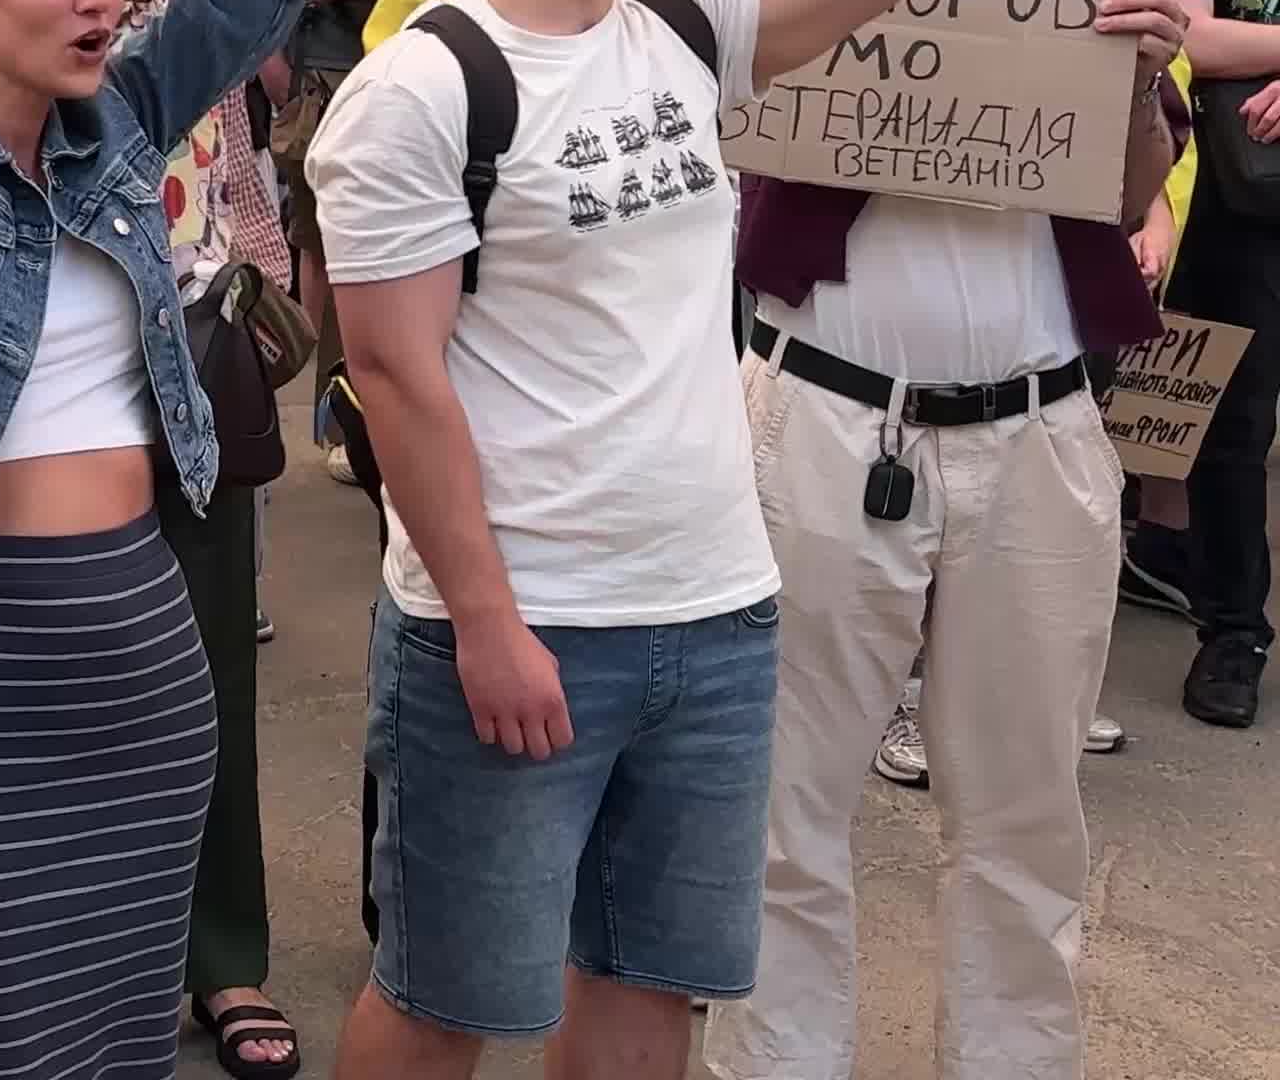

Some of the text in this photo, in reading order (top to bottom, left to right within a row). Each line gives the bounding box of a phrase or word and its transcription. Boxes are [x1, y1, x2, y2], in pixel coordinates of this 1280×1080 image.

[825, 32, 942, 81] МО
[957, 103, 1077, 161] ДЛЯ
[834, 143, 1046, 192] ВЕТЕРАНІВ
[1136, 415, 1198, 446] ФРОНТ
